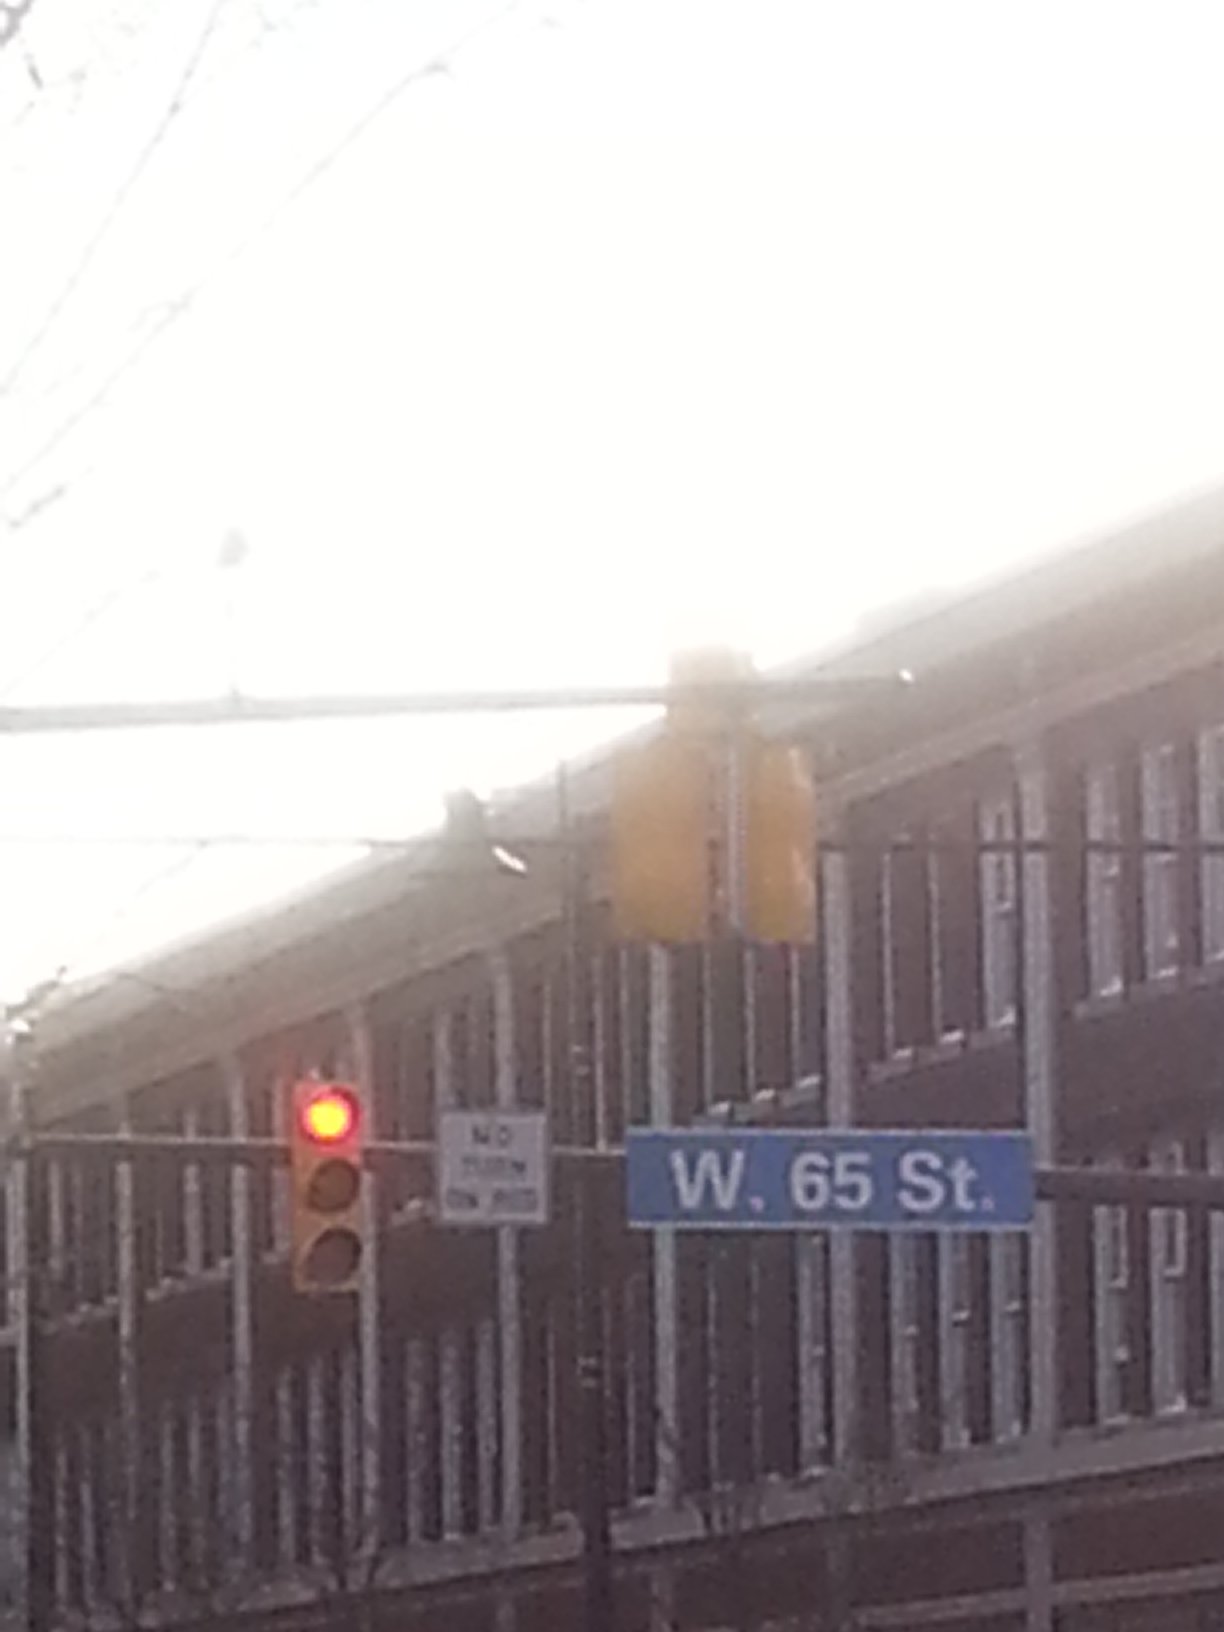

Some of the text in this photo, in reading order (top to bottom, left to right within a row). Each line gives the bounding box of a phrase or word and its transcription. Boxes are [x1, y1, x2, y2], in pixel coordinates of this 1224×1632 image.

[669, 1149, 996, 1213] W. 65 St.
